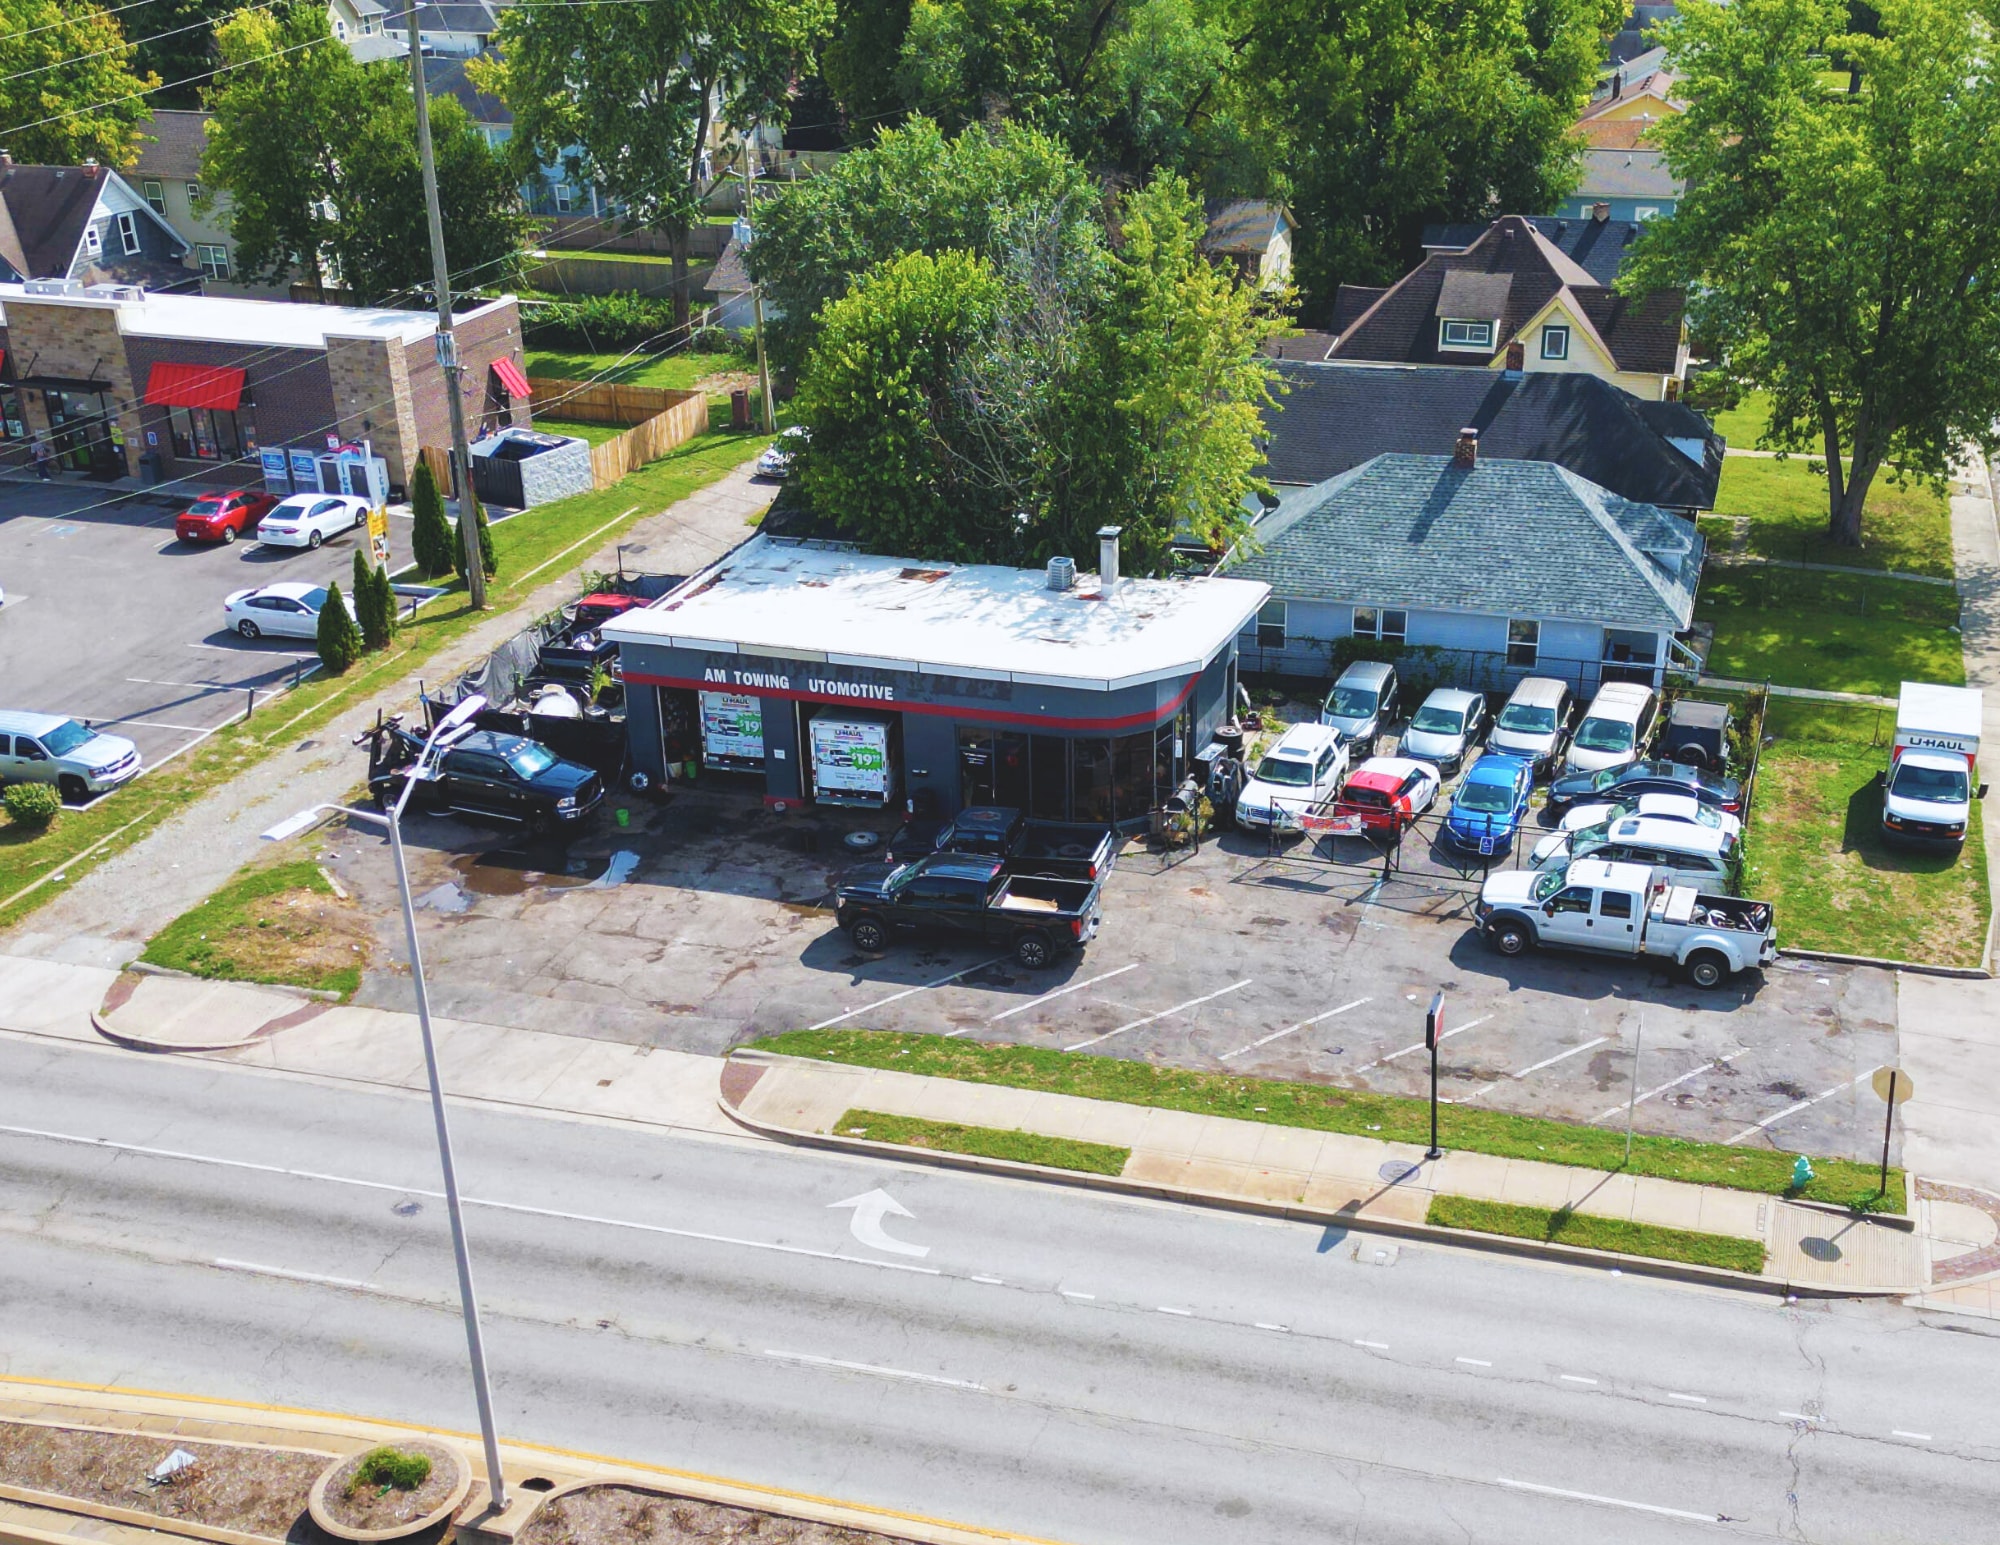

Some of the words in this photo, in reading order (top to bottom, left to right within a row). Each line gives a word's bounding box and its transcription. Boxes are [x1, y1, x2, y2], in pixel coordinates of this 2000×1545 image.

[704, 668, 727, 683] AM
[733, 670, 790, 690] TOWING
[808, 678, 894, 701] UTOMOTIVE
[1909, 736, 1966, 751] U-HAUL
